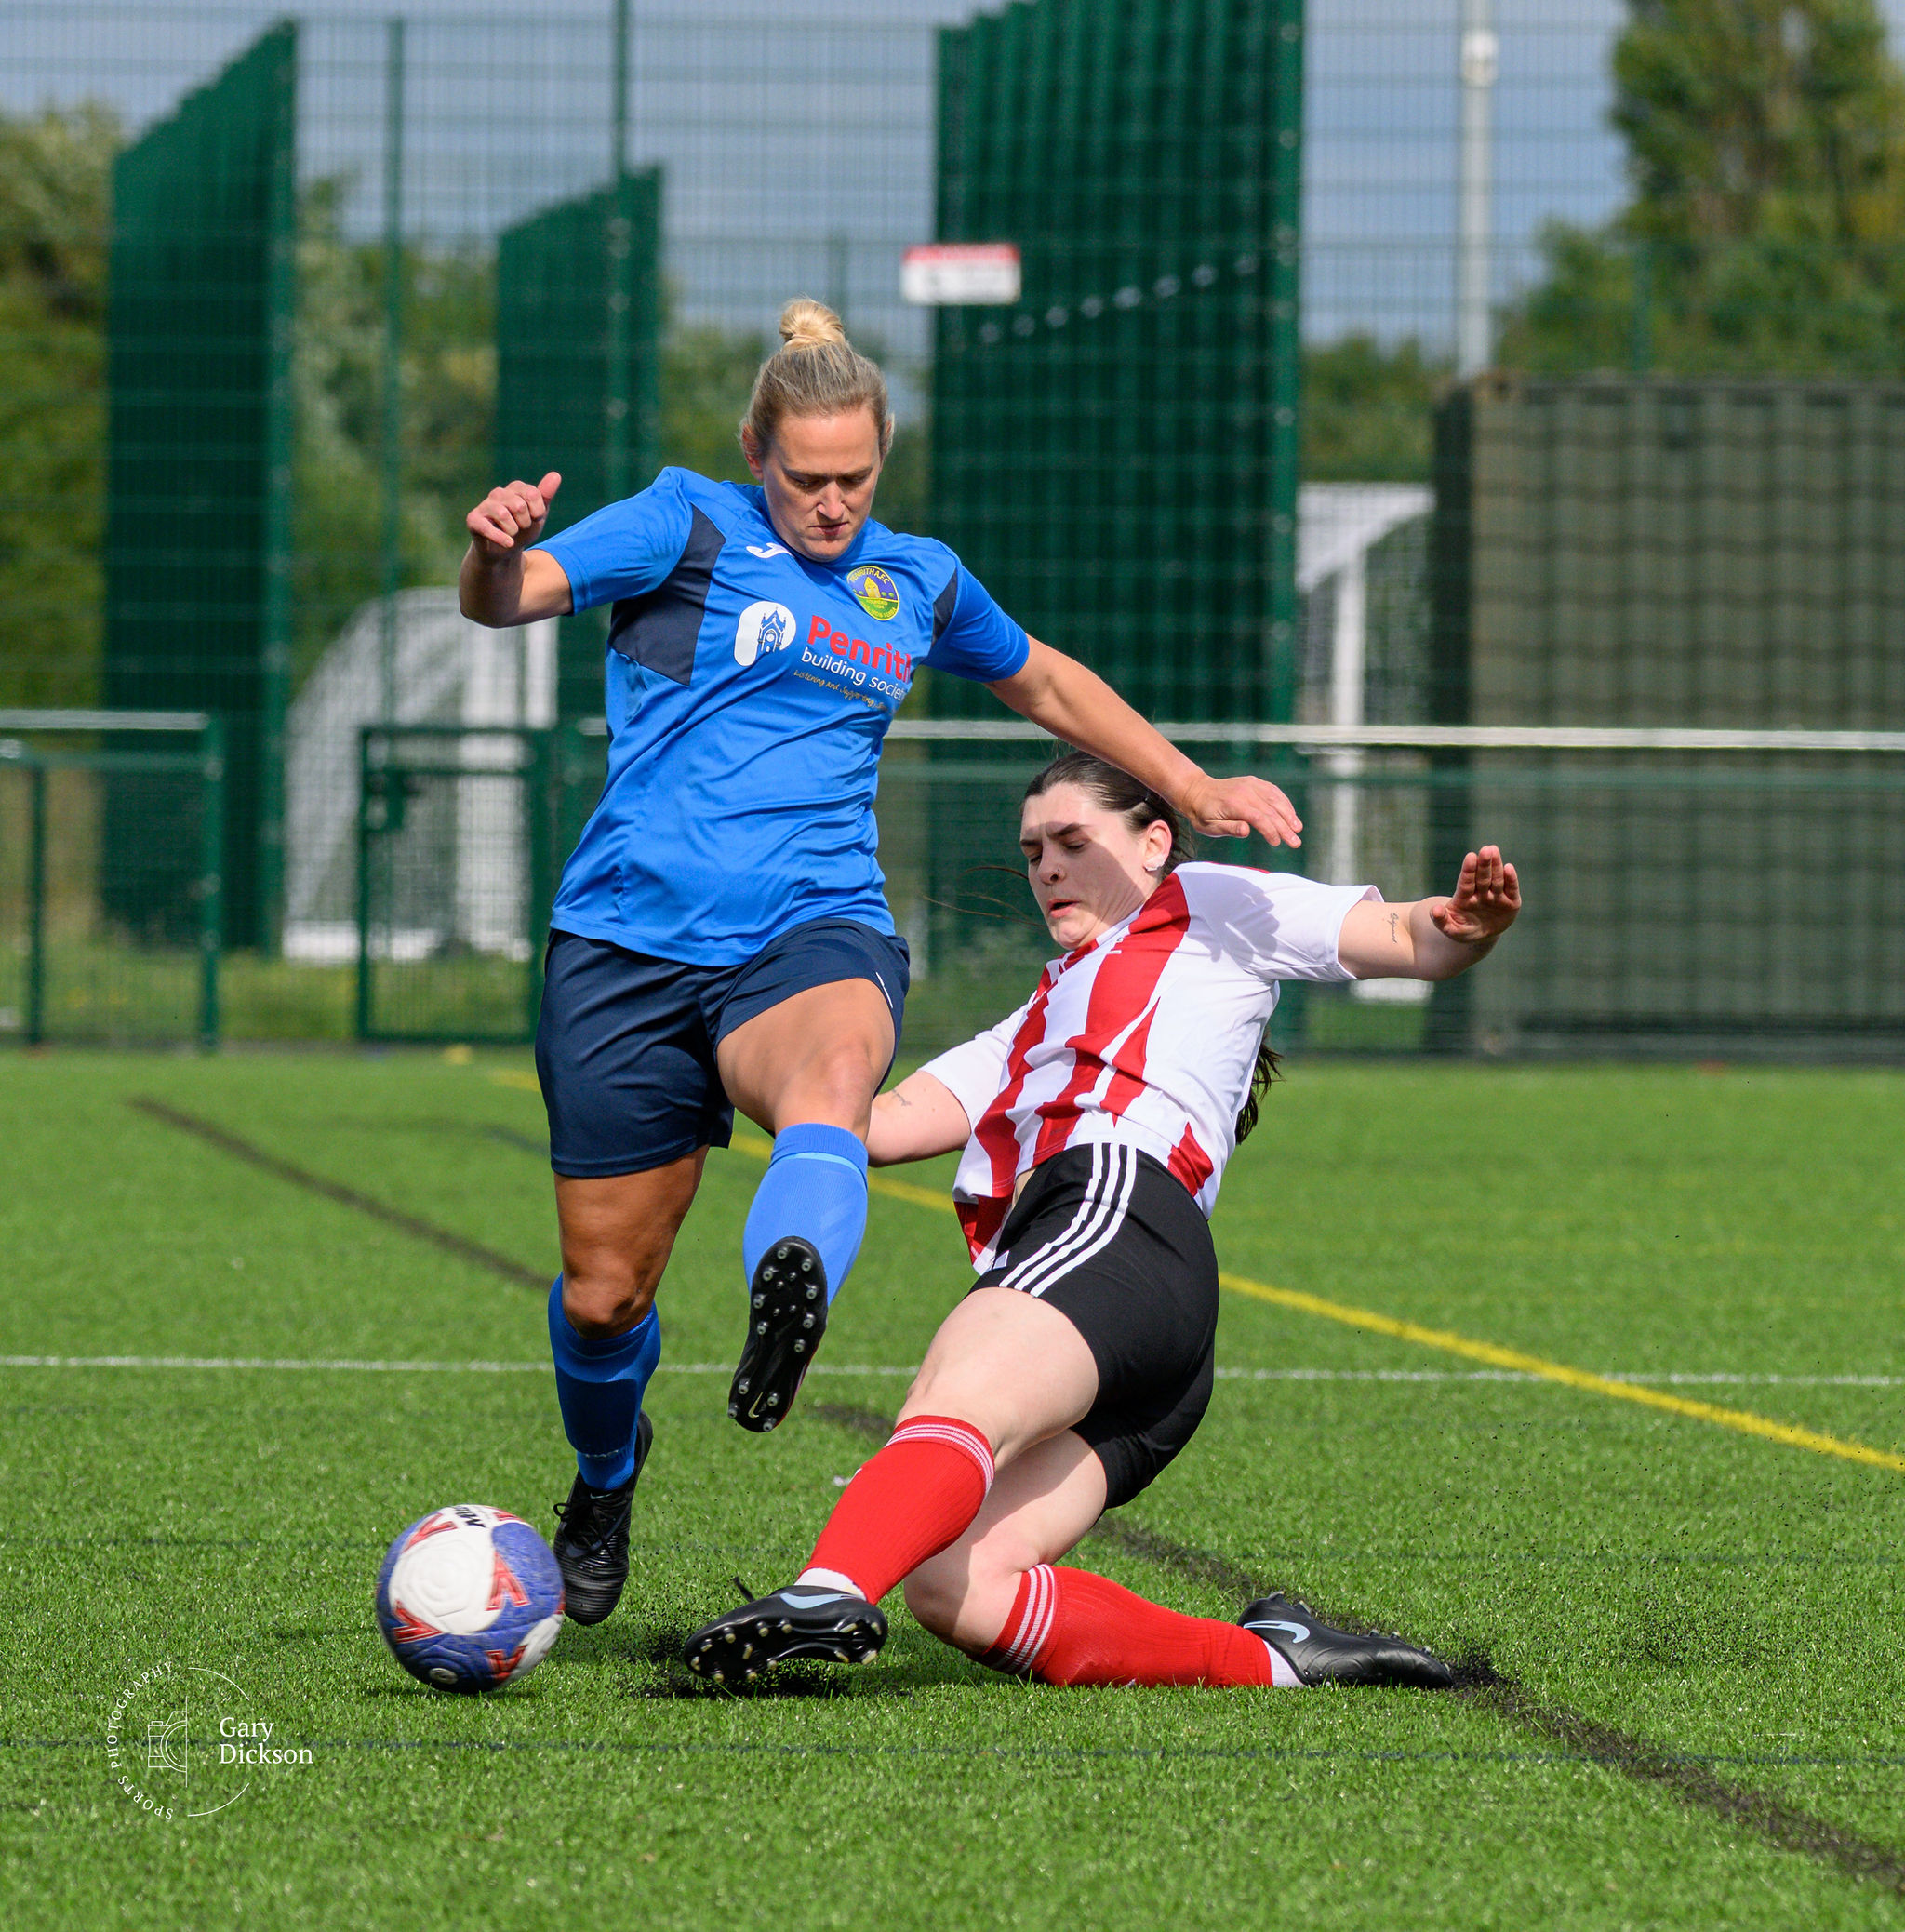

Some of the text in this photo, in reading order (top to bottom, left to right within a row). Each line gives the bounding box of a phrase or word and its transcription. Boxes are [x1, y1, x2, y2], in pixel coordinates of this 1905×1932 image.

[793, 670, 825, 687] Listening
[825, 681, 839, 690] and
[801, 646, 866, 686] building
